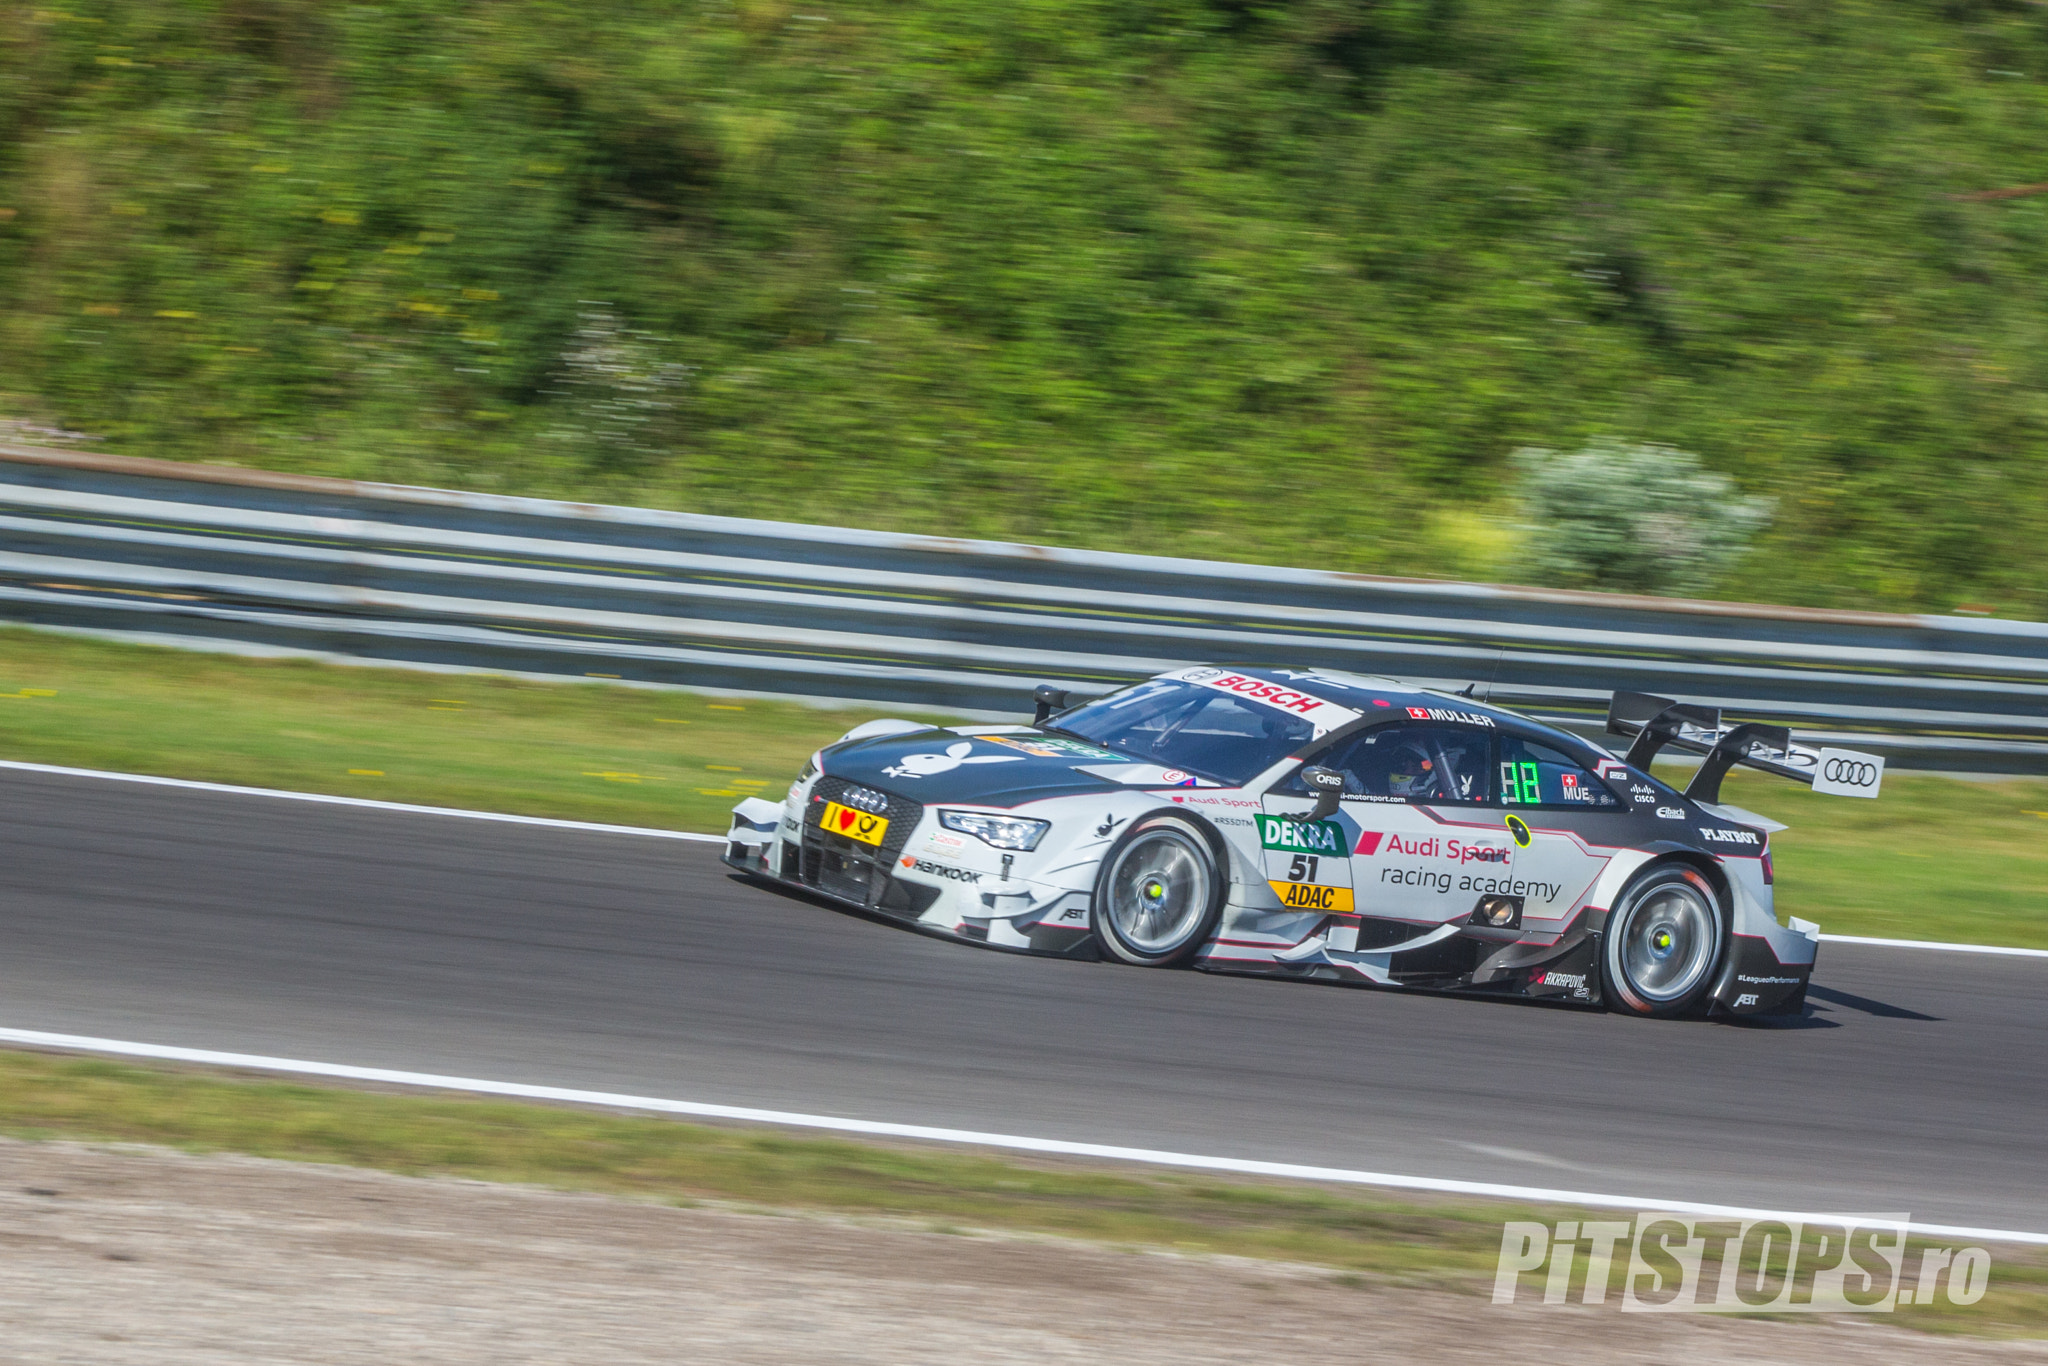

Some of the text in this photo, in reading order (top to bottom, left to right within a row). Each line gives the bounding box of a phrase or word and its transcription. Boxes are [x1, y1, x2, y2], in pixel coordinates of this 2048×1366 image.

[1212, 675, 1324, 713] BOSCH
[1316, 774, 1342, 786] ORIS
[1188, 797, 1262, 808] Audi Sport
[1563, 787, 1590, 800] MUE
[1264, 819, 1337, 851] DEKRA
[1699, 828, 1760, 844] PLAYBOY
[1386, 834, 1511, 865] Audi Sport
[1288, 854, 1319, 883] 51
[1381, 866, 1562, 903] racing academy
[1285, 884, 1335, 909] ADAC
[1058, 908, 1086, 921] ABT
[1733, 993, 1760, 1008] ABT
